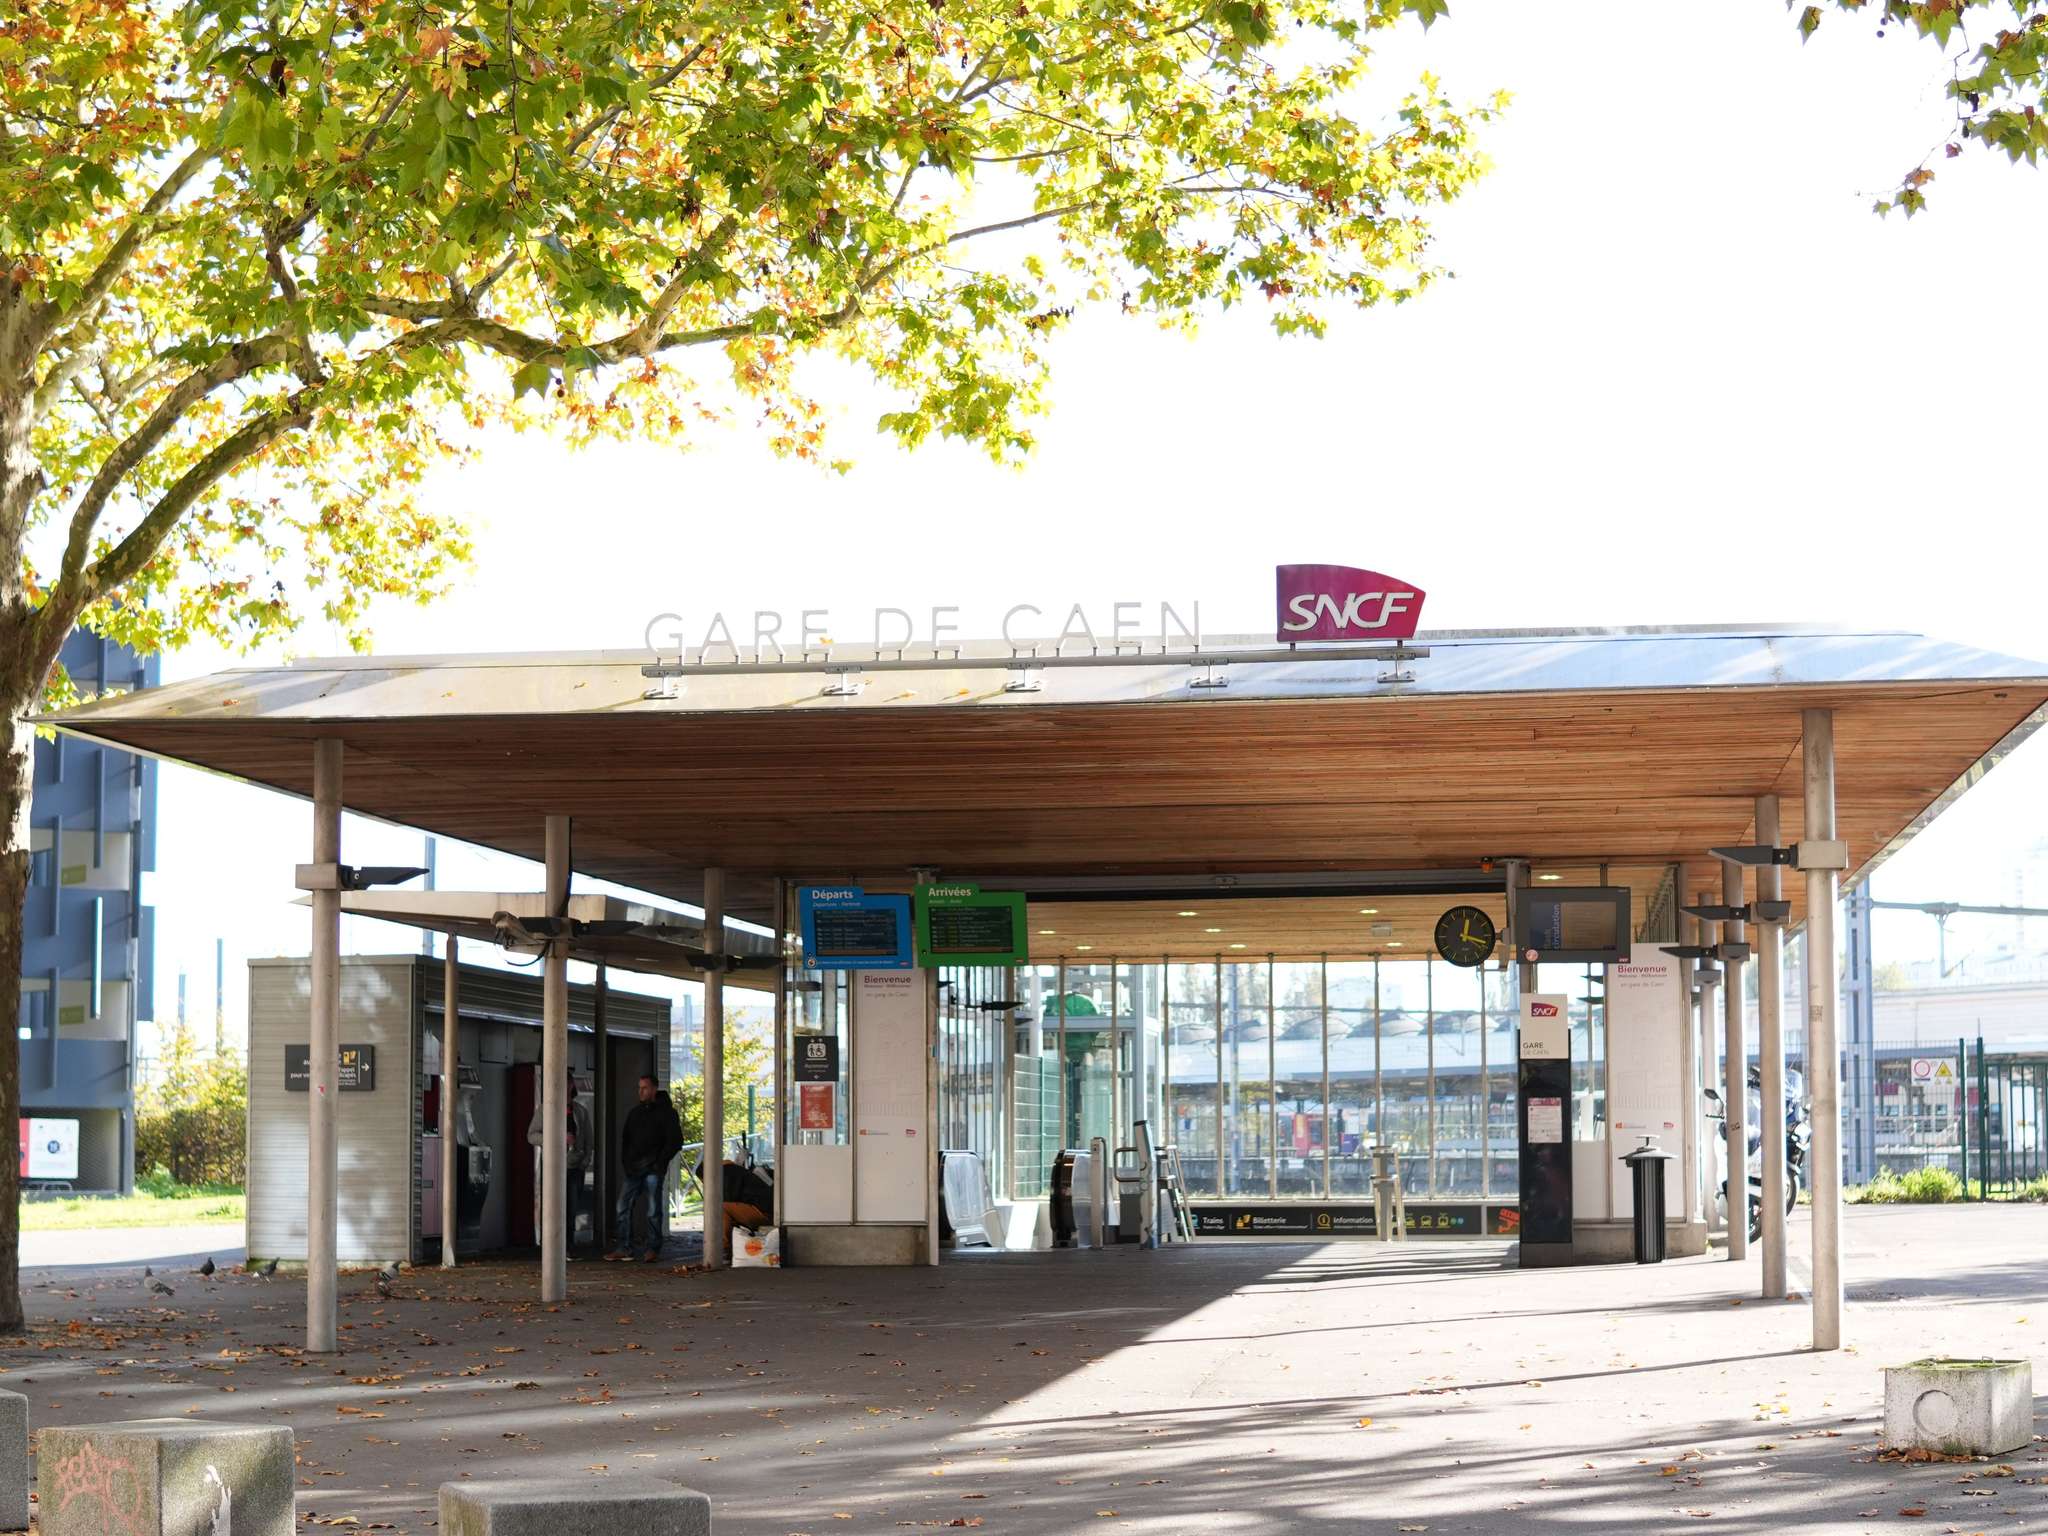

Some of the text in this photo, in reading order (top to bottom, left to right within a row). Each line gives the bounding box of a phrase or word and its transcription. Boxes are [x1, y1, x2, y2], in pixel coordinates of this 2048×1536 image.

[1282, 592, 1414, 631] SNCF
[645, 600, 1199, 658] GARE DE CAEN
[812, 889, 854, 901] Départs
[928, 887, 972, 897] Arrivées
[1617, 965, 1667, 973] Bienvenue
[864, 975, 912, 984] Bienvenue
[1532, 1007, 1557, 1016] SNCF
[1522, 1041, 1544, 1049] GARE
[1202, 1216, 1374, 1224] Trains Billetterie Information
